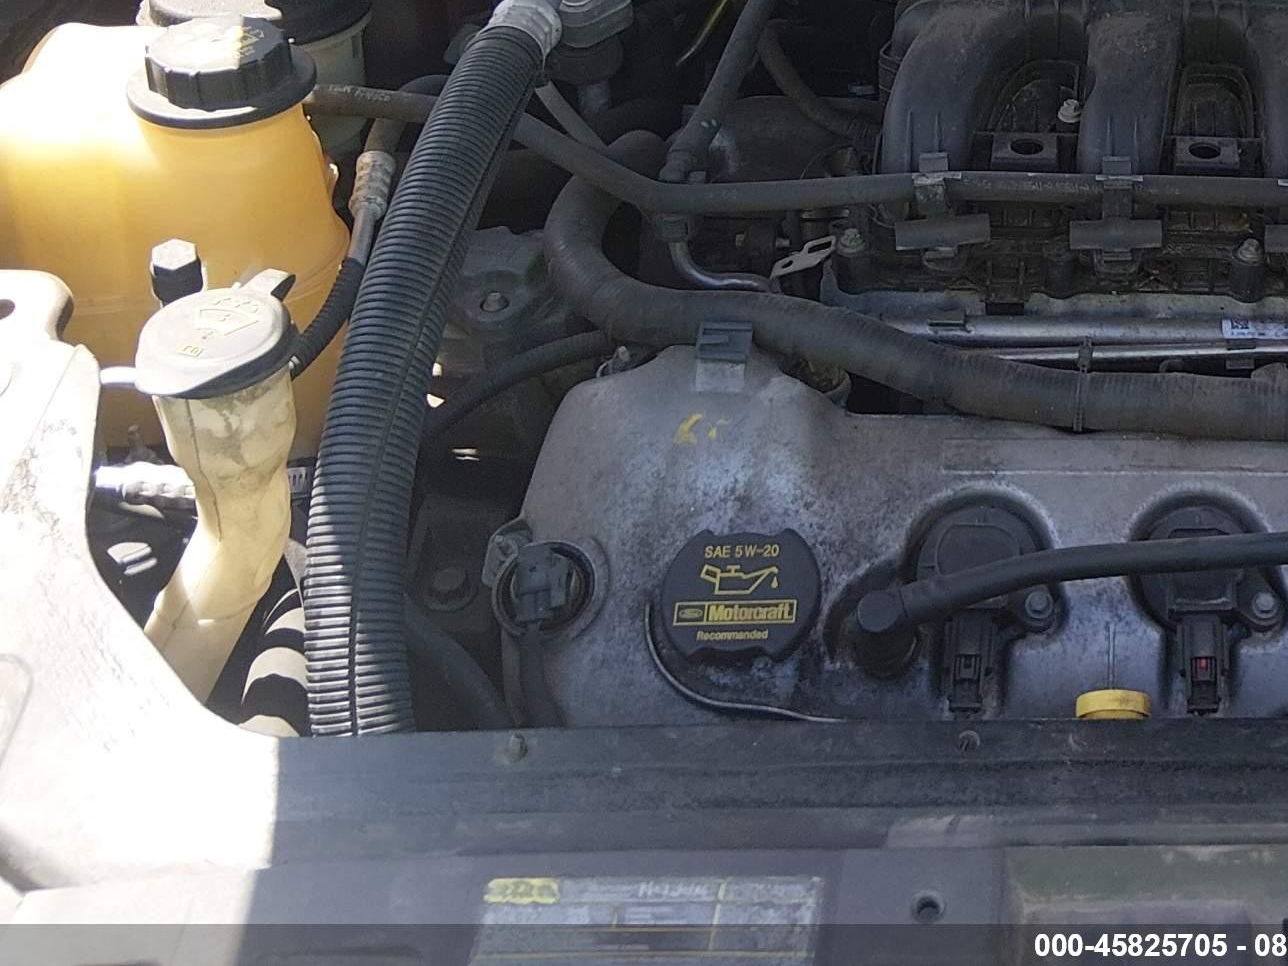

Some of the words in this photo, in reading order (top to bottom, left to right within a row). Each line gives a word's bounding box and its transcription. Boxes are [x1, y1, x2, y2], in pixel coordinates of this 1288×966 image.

[704, 545, 731, 559] SAE
[735, 544, 780, 558] 5W-20
[708, 603, 793, 622] Motorcraft
[696, 629, 769, 641] Recommended
